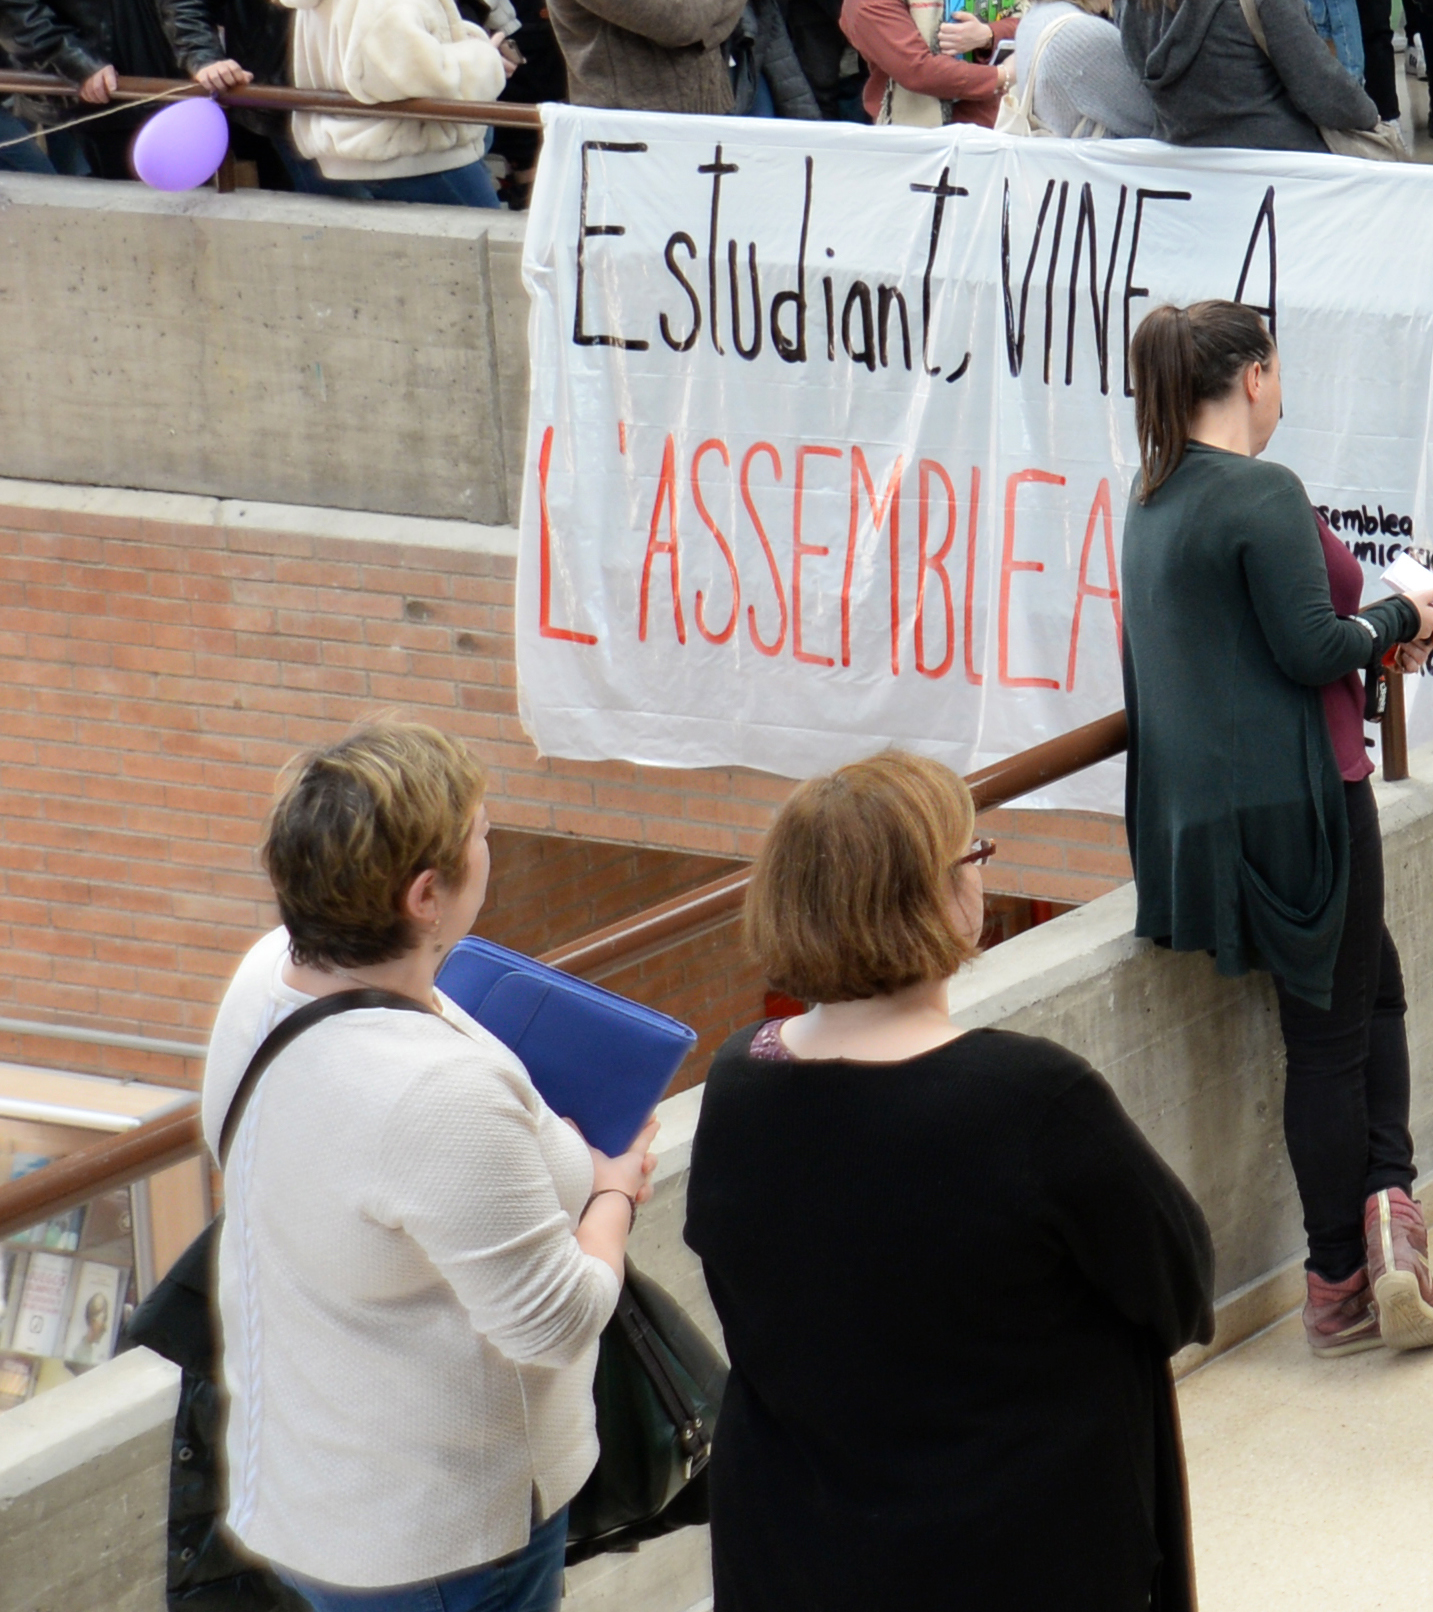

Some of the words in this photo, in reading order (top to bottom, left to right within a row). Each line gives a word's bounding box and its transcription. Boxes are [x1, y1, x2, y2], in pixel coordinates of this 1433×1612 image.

[572, 140, 971, 384] Estudiant,
[1001, 177, 1192, 398] VINE
[538, 421, 1123, 693] L'ASSEMBLEA
[1315, 504, 1414, 537] semblea
